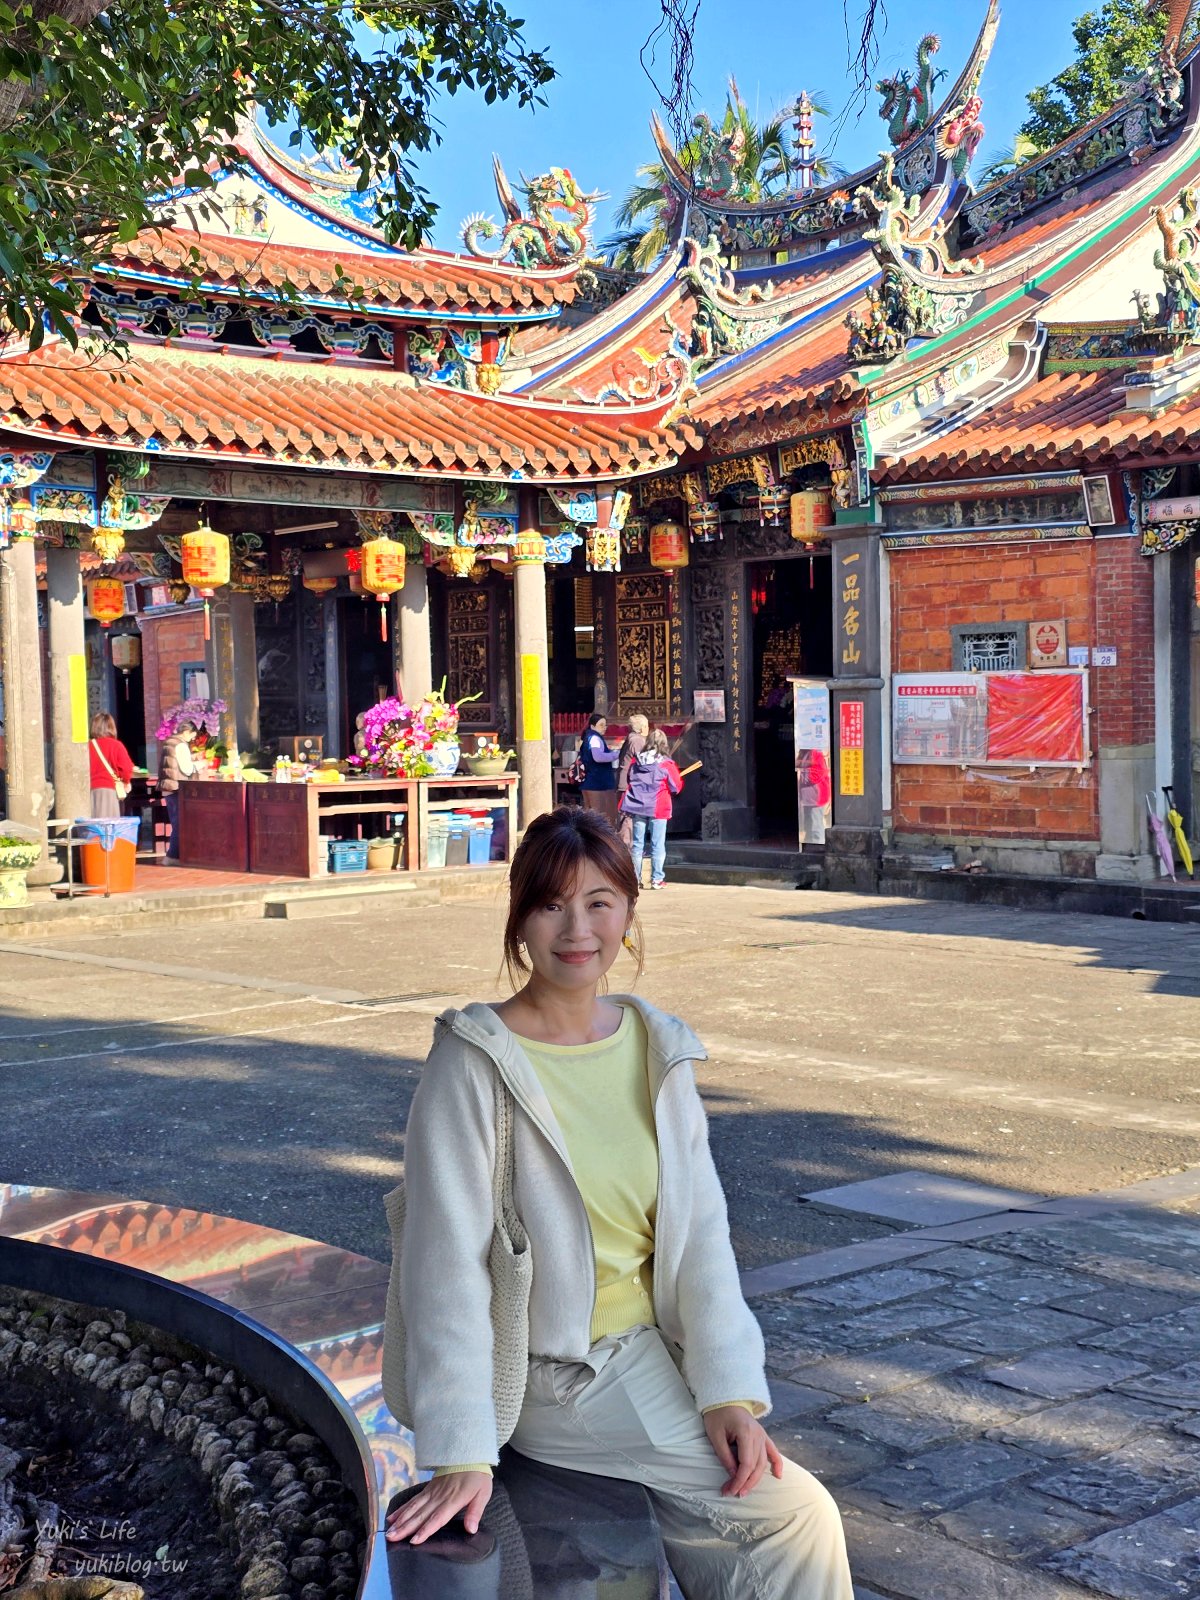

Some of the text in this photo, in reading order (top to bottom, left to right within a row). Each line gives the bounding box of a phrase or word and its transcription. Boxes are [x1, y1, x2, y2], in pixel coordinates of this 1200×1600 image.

[841, 552, 861, 665] 一品名山
[1101, 655, 1111, 665] 28
